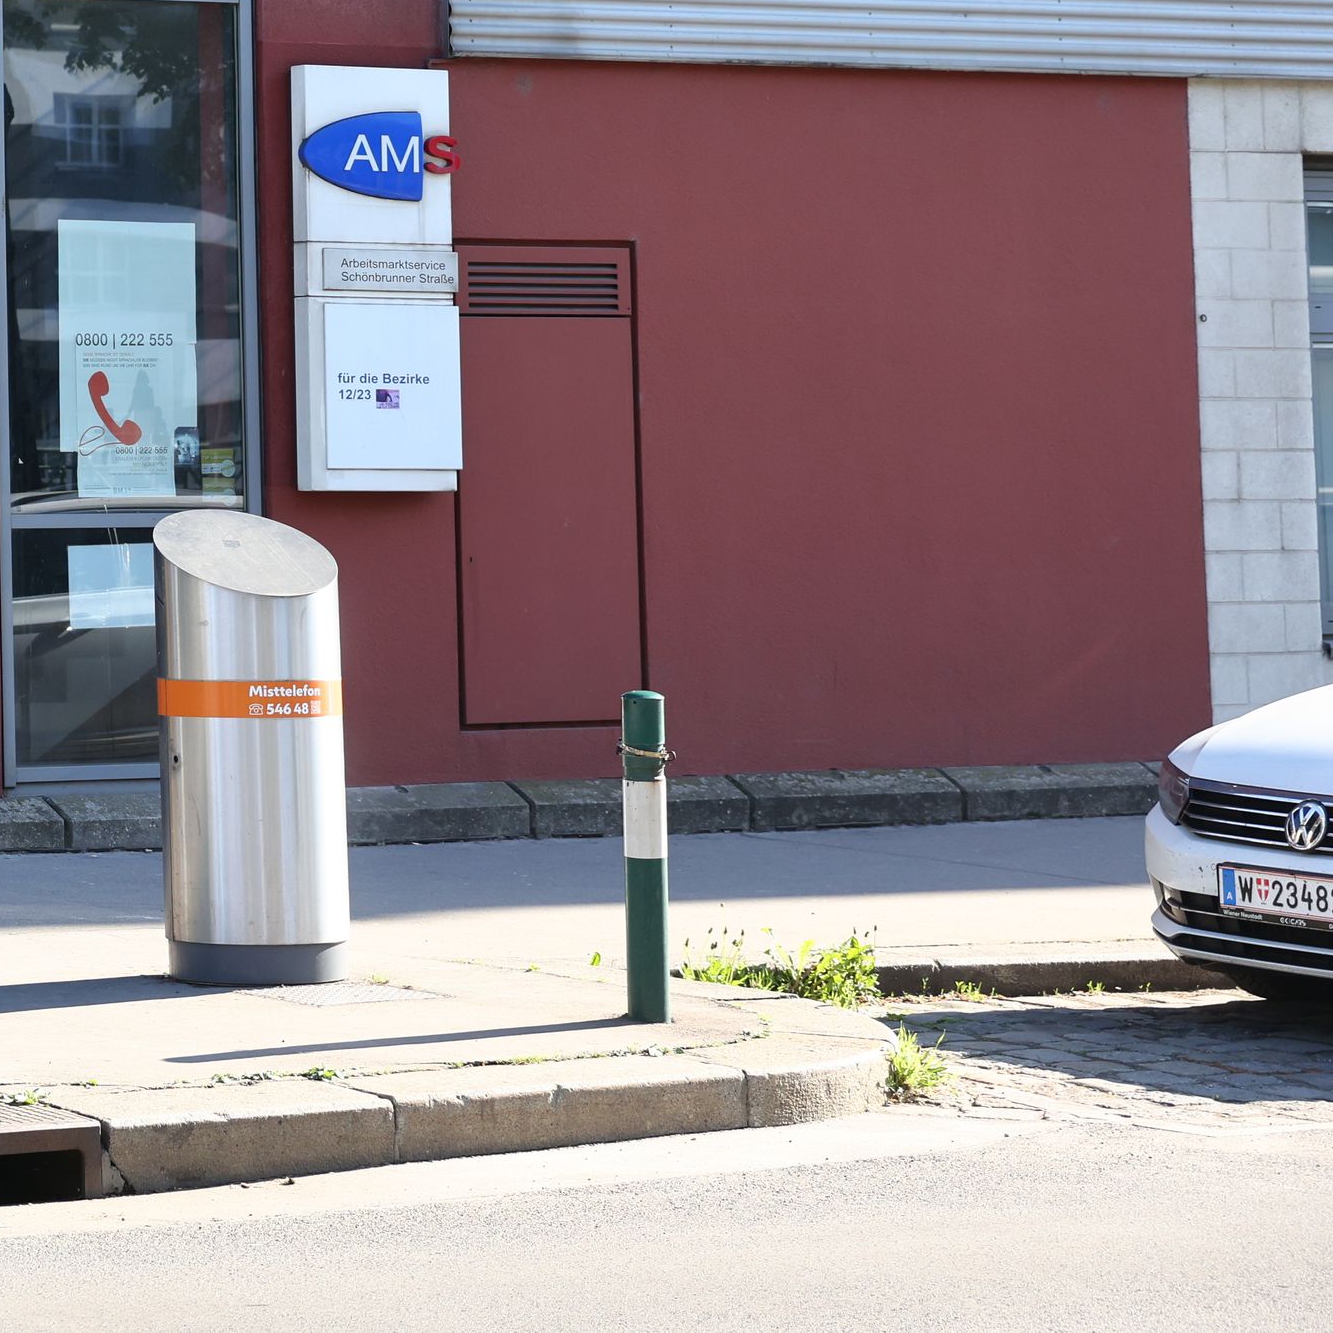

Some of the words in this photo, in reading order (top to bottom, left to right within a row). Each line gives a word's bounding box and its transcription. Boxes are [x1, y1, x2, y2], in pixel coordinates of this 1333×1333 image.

[344, 133, 461, 175] AMS
[341, 258, 446, 271] Arbeitsmarktservice
[341, 271, 416, 283] Schönbrunner
[419, 273, 454, 284] Straße
[76, 333, 108, 346] 0800
[120, 333, 144, 346] 222
[149, 333, 173, 346] 555
[338, 372, 356, 384] für
[359, 373, 378, 384] die
[383, 373, 430, 385] Bezirke
[339, 389, 371, 400] 12/23
[115, 447, 133, 455] 0800
[139, 447, 152, 455] 222
[249, 684, 321, 697] Misttelefon
[266, 703, 291, 715] 546
[293, 703, 309, 715] 48
[1238, 875, 1253, 904] W
[1272, 880, 1333, 914] 2348
